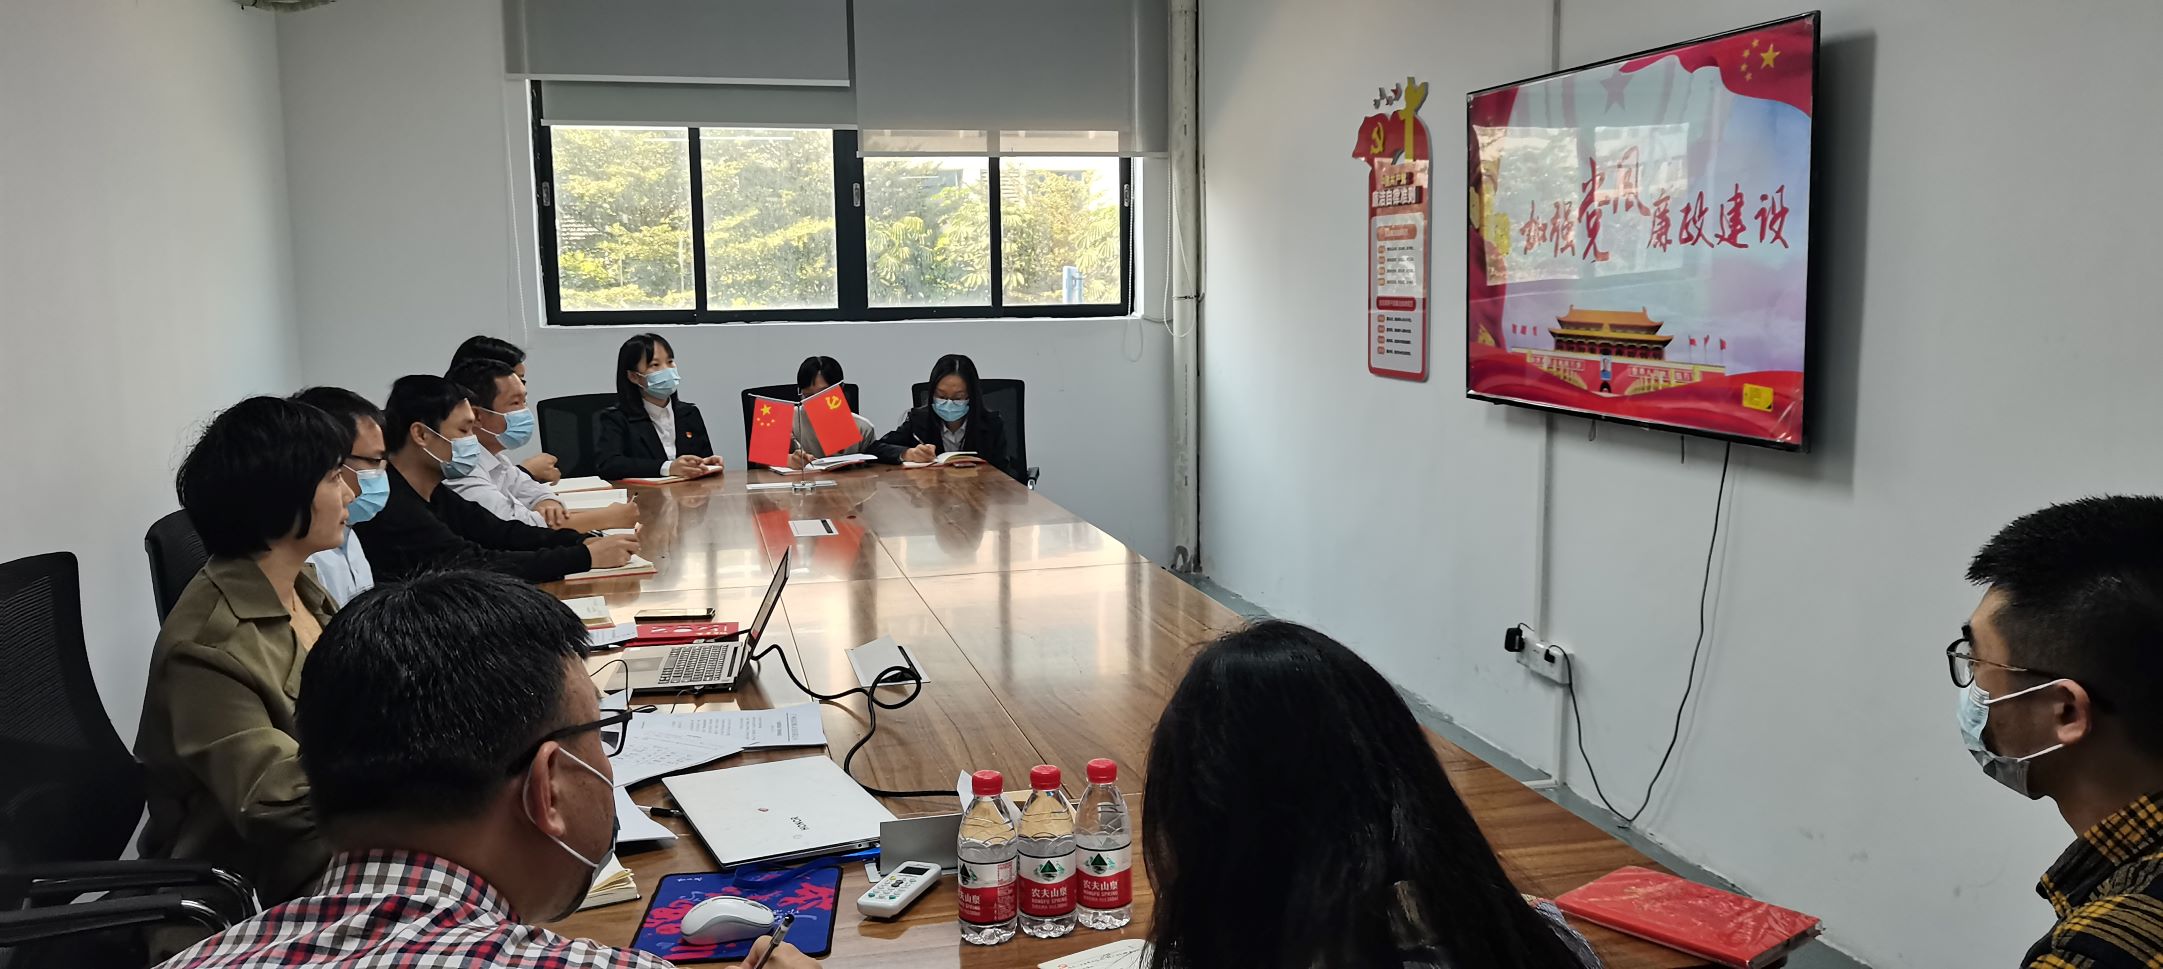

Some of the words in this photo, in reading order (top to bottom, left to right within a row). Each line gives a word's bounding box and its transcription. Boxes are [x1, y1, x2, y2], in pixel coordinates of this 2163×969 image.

[1520, 146, 1789, 263] 加强党风廉政建设
[1083, 880, 1118, 891] 农夫山泉
[1031, 887, 1067, 898] 农夫山泉
